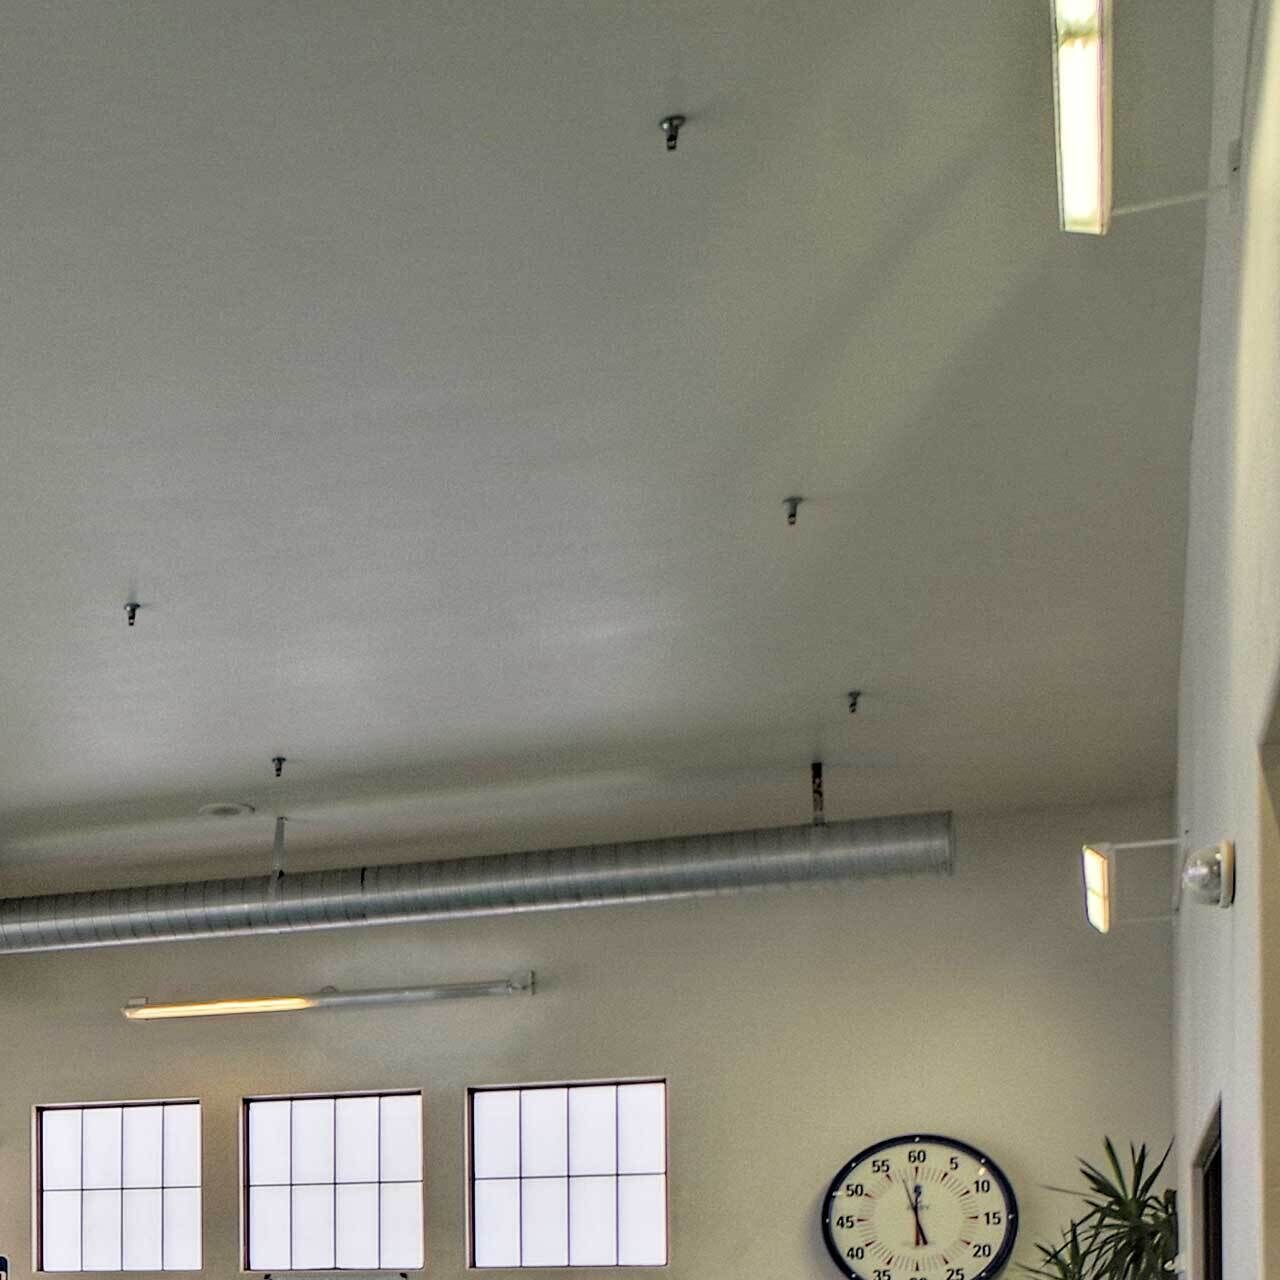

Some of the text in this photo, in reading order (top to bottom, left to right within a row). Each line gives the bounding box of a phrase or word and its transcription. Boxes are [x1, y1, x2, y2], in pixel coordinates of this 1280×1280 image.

[908, 1150, 926, 1163] 60
[872, 1160, 890, 1173] 55
[950, 1157, 959, 1171] 5
[846, 1184, 864, 1197] 50
[974, 1180, 991, 1193] 10
[836, 1216, 854, 1229] 45
[984, 1212, 1001, 1225] 15
[846, 1247, 864, 1260] 40
[973, 1244, 991, 1258] 20
